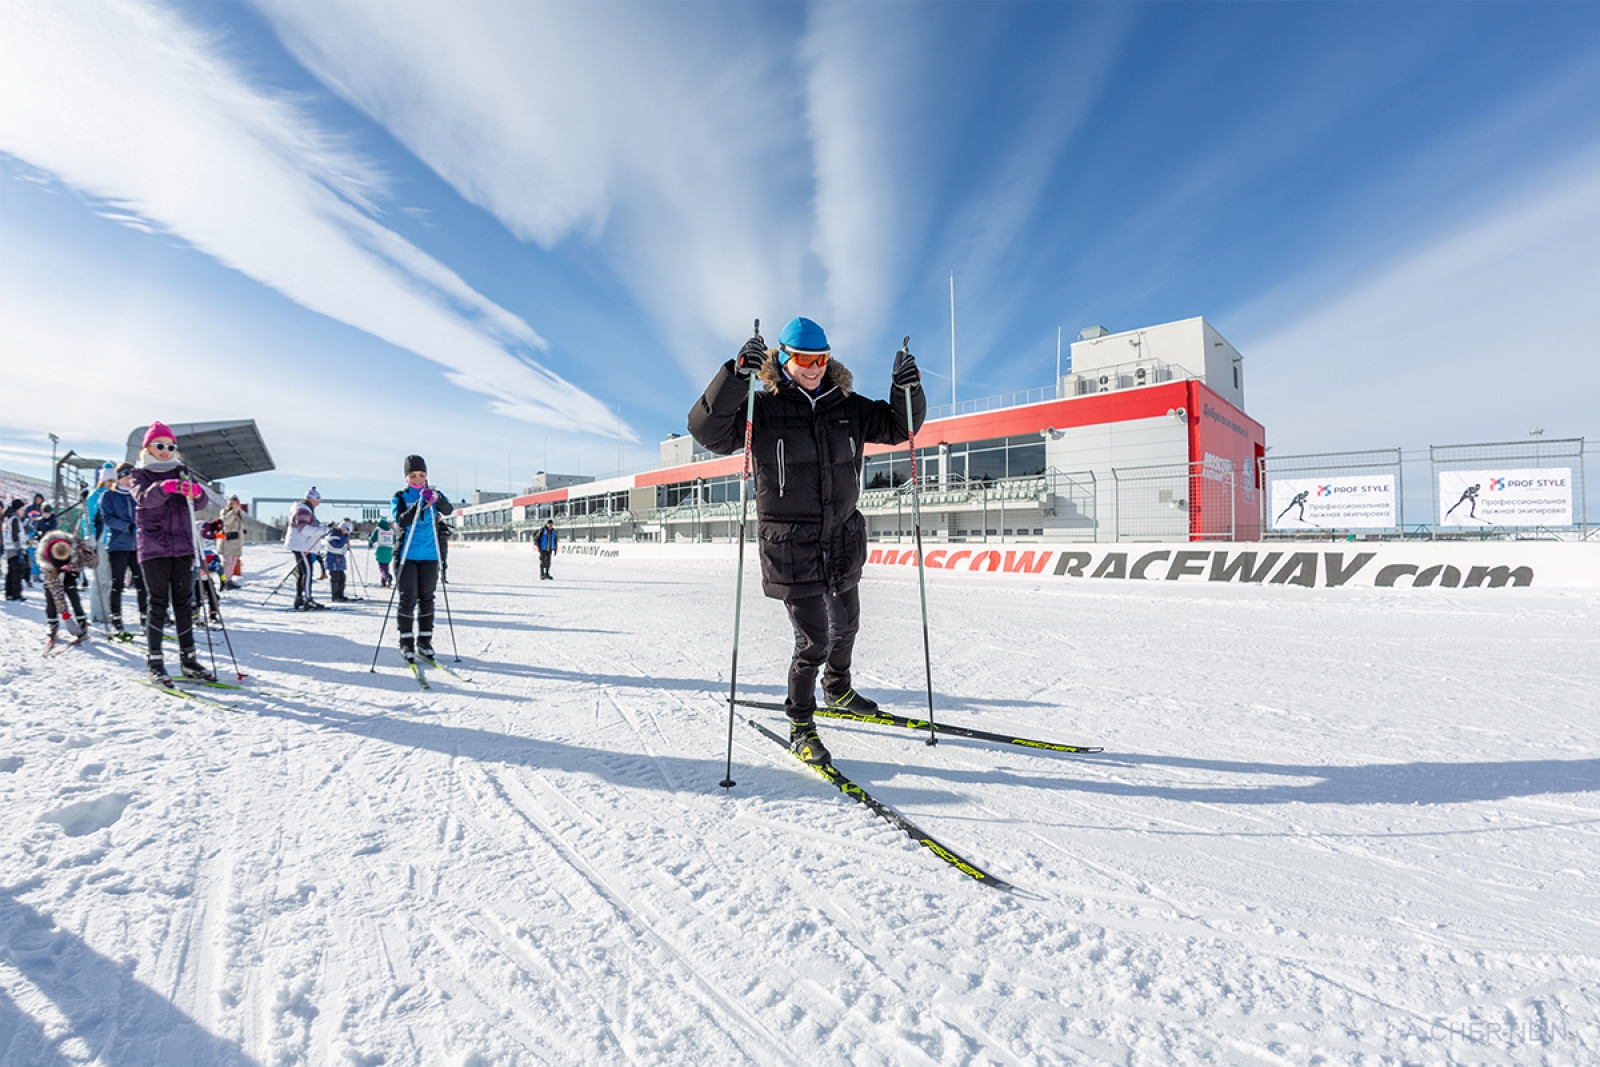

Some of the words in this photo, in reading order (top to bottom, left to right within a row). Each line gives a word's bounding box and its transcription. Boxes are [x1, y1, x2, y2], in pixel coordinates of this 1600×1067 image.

[1508, 480, 1533, 488] PROF
[1537, 479, 1566, 487] STYLE
[1361, 484, 1389, 492] STYLE
